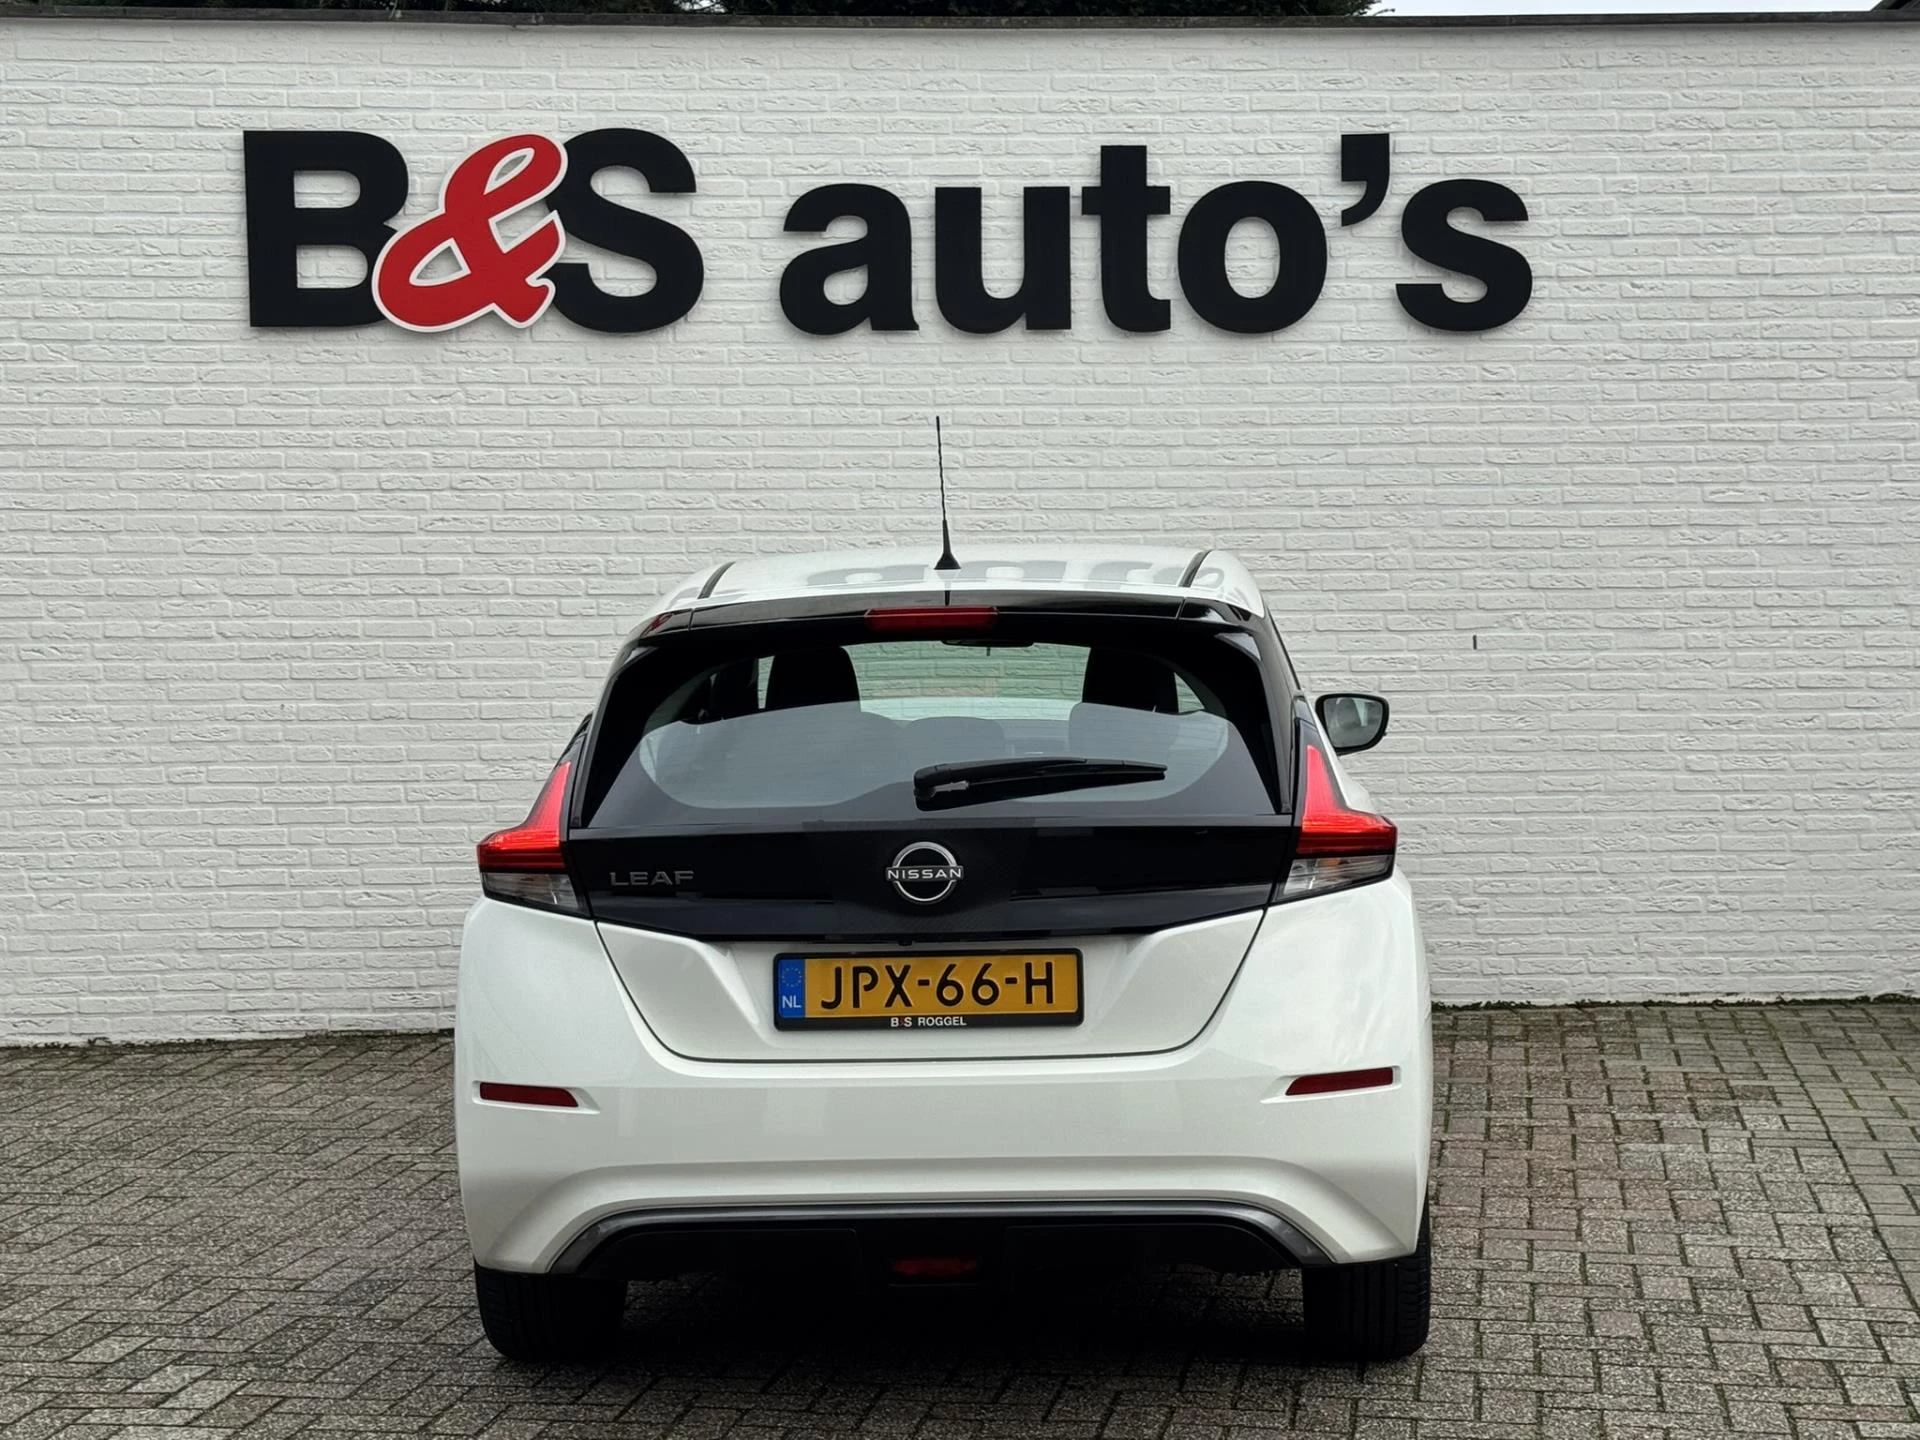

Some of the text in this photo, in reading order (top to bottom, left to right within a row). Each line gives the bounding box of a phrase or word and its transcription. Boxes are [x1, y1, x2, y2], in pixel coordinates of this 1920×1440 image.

[243, 128, 1532, 335] B&S auto’s
[609, 870, 694, 886] LEAF
[887, 868, 962, 879] NISSAN
[820, 961, 1054, 1010] JPX-66-H
[781, 996, 802, 1009] NL
[917, 1016, 967, 1027] ROGGEL
